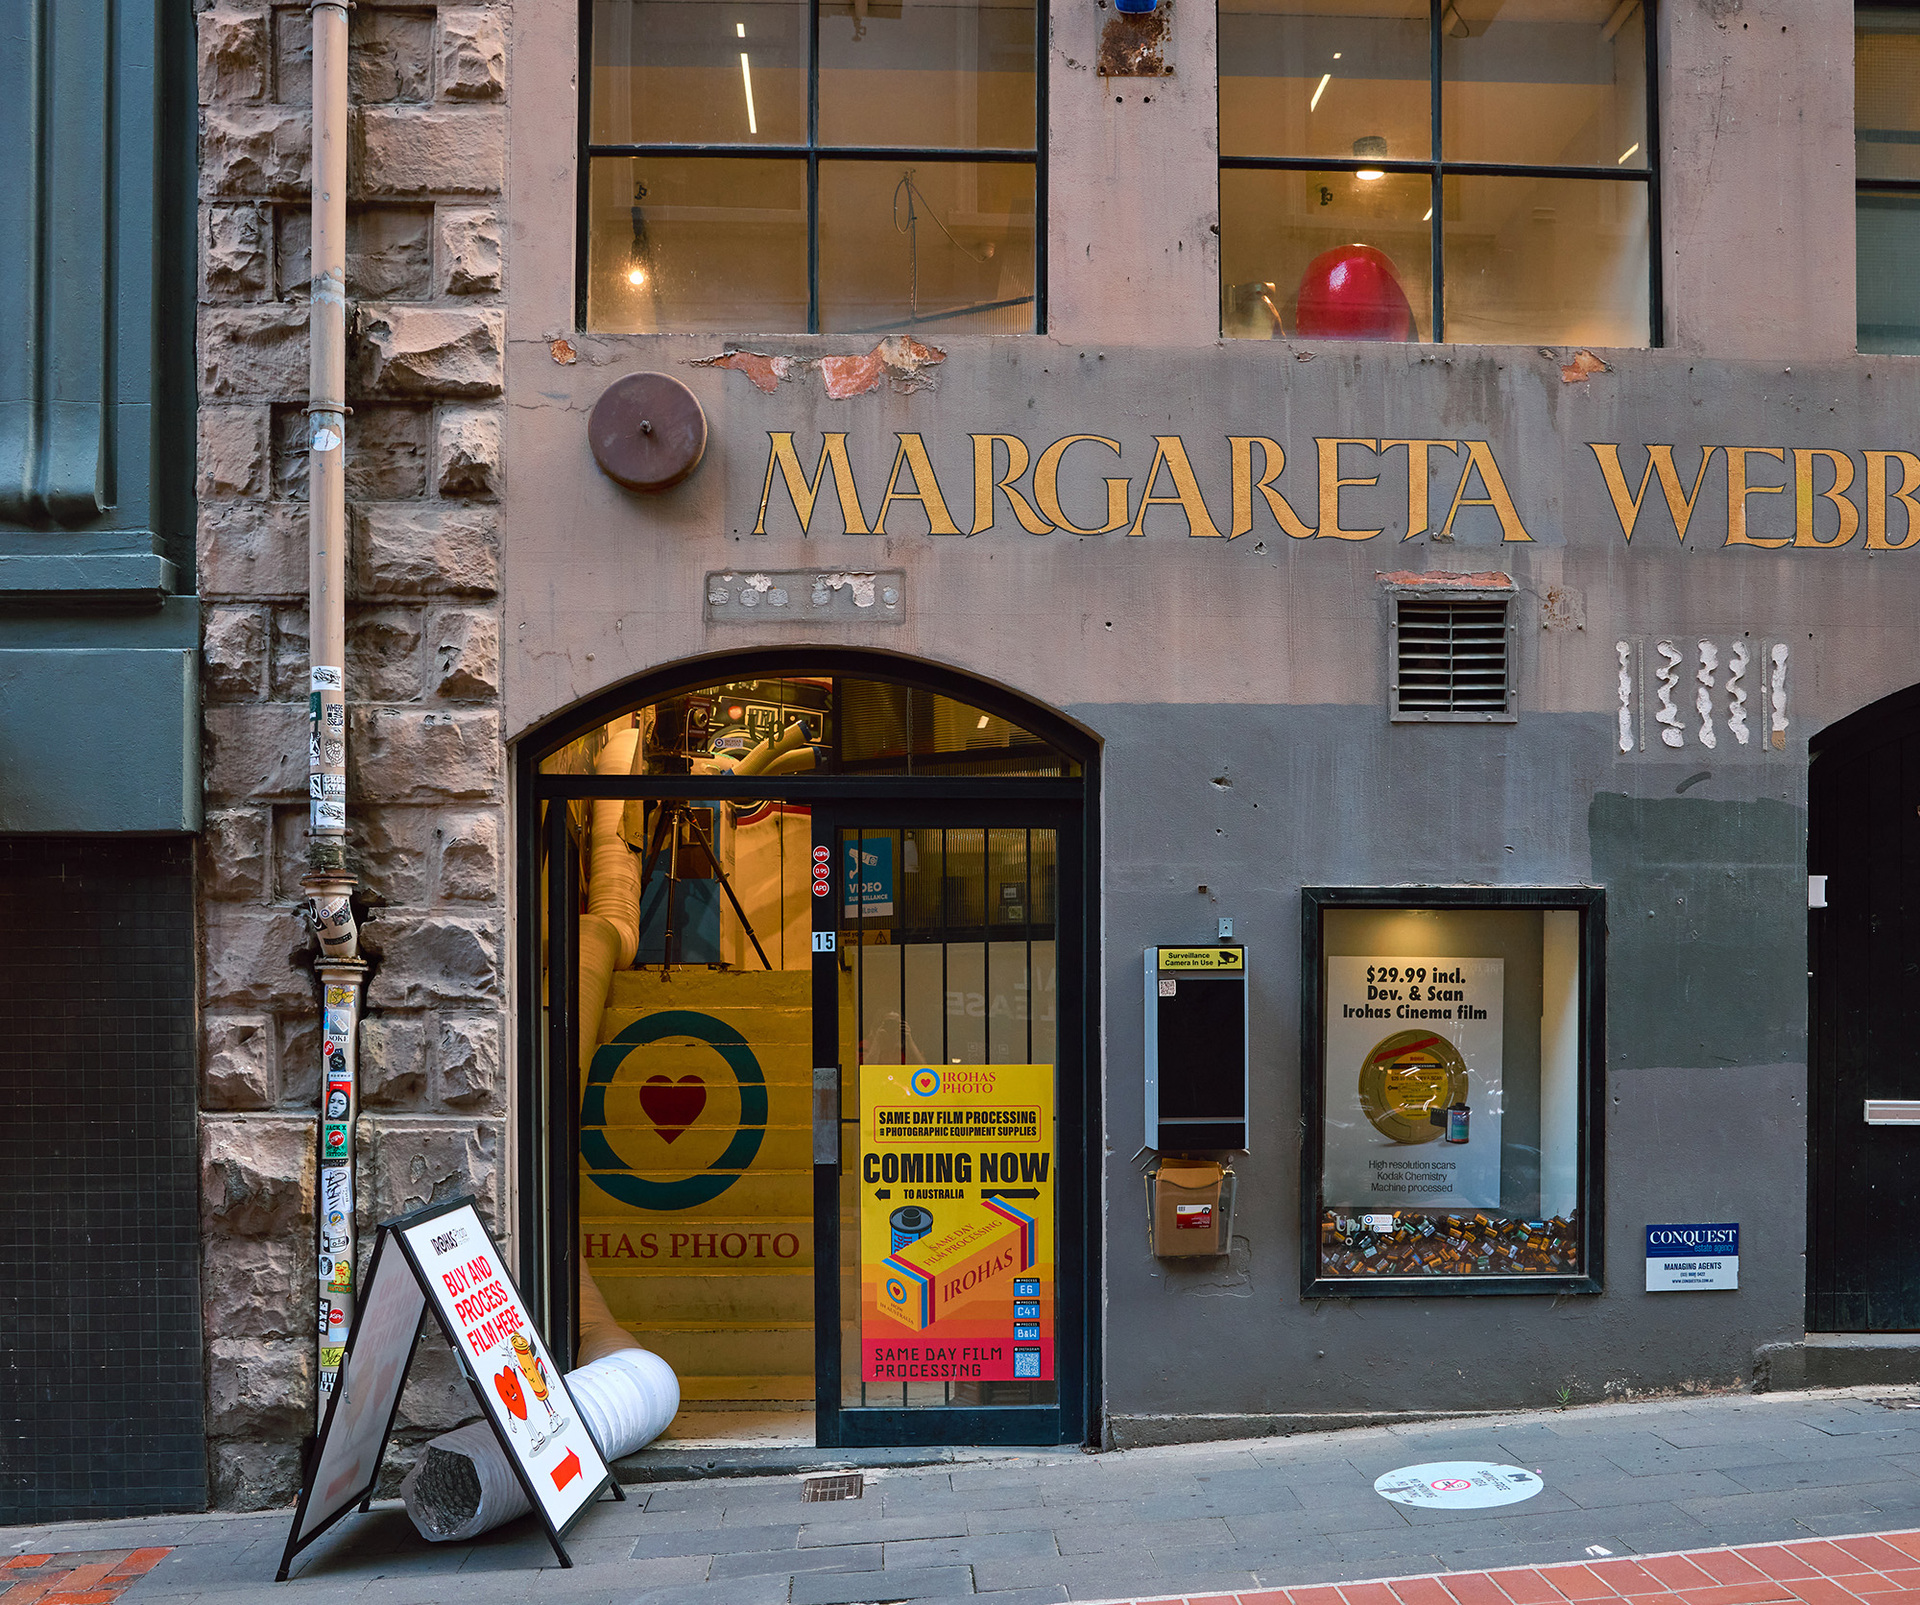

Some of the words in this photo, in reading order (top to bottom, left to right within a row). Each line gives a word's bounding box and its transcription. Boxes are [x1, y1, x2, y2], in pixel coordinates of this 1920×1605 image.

[750, 431, 1537, 544] MARGARETA
[1583, 441, 1920, 550] WEBB
[814, 850, 829, 858] ASPH
[848, 881, 882, 894] VIDEO
[815, 933, 834, 949] 15
[1366, 965, 1427, 984] $29.99
[1432, 967, 1466, 984] incl.
[1367, 985, 1403, 1001] Dev.
[1408, 985, 1422, 1001] &
[1427, 985, 1464, 1002] Scan
[1343, 1004, 1391, 1019] Irohas
[1396, 1004, 1452, 1019] Cinema
[1457, 1005, 1488, 1020] film
[942, 1072, 996, 1082] IROHAS
[942, 1083, 994, 1094] PHOTO
[879, 1111, 911, 1125] SAME
[913, 1111, 935, 1125] DAY
[936, 1111, 964, 1125] FILM
[965, 1111, 1037, 1124] PROCESSING
[885, 1127, 949, 1137] PHOTOGRAPHIC
[950, 1127, 997, 1137] EQUIPMENT
[997, 1126, 1037, 1136] SUPPLIES
[863, 1152, 972, 1184] COMING
[979, 1152, 1050, 1183] NOW
[1368, 1160, 1388, 1170] High
[1388, 1160, 1430, 1170] resolution
[1431, 1161, 1456, 1170] scans
[1377, 1171, 1403, 1181] Kodak
[1404, 1171, 1448, 1183] Chemistry
[903, 1189, 915, 1200] TO
[916, 1189, 965, 1200] AUSTRALIA
[1371, 1182, 1406, 1192] Machine
[1407, 1183, 1453, 1193] processed
[430, 1230, 459, 1256] IROHAS
[923, 1251, 948, 1266] FILM
[945, 1219, 1003, 1254] PROCESSING
[930, 1234, 957, 1251] SAME
[953, 1223, 974, 1237] DAY
[1649, 1229, 1737, 1247] CONQUEST
[583, 1232, 660, 1259] HAS
[669, 1232, 800, 1259] PHOTO
[1694, 1244, 1713, 1253] estate
[1713, 1244, 1735, 1254] agency
[1663, 1262, 1697, 1271] MANAGING
[1697, 1261, 1722, 1270] AGENTS
[442, 1265, 471, 1298] BUY
[466, 1255, 492, 1285] AND
[944, 1247, 1013, 1303] IROHAS
[1019, 1285, 1033, 1294] E6
[454, 1279, 508, 1327] PROCESS
[1017, 1307, 1036, 1316] C41
[466, 1320, 500, 1357] FILM
[491, 1305, 524, 1340] HERE
[1017, 1328, 1037, 1338] B&W
[875, 1348, 924, 1361] SAME
[925, 1348, 957, 1360] DAY
[963, 1347, 1002, 1360] FILM
[875, 1363, 982, 1377] PROCESSING
